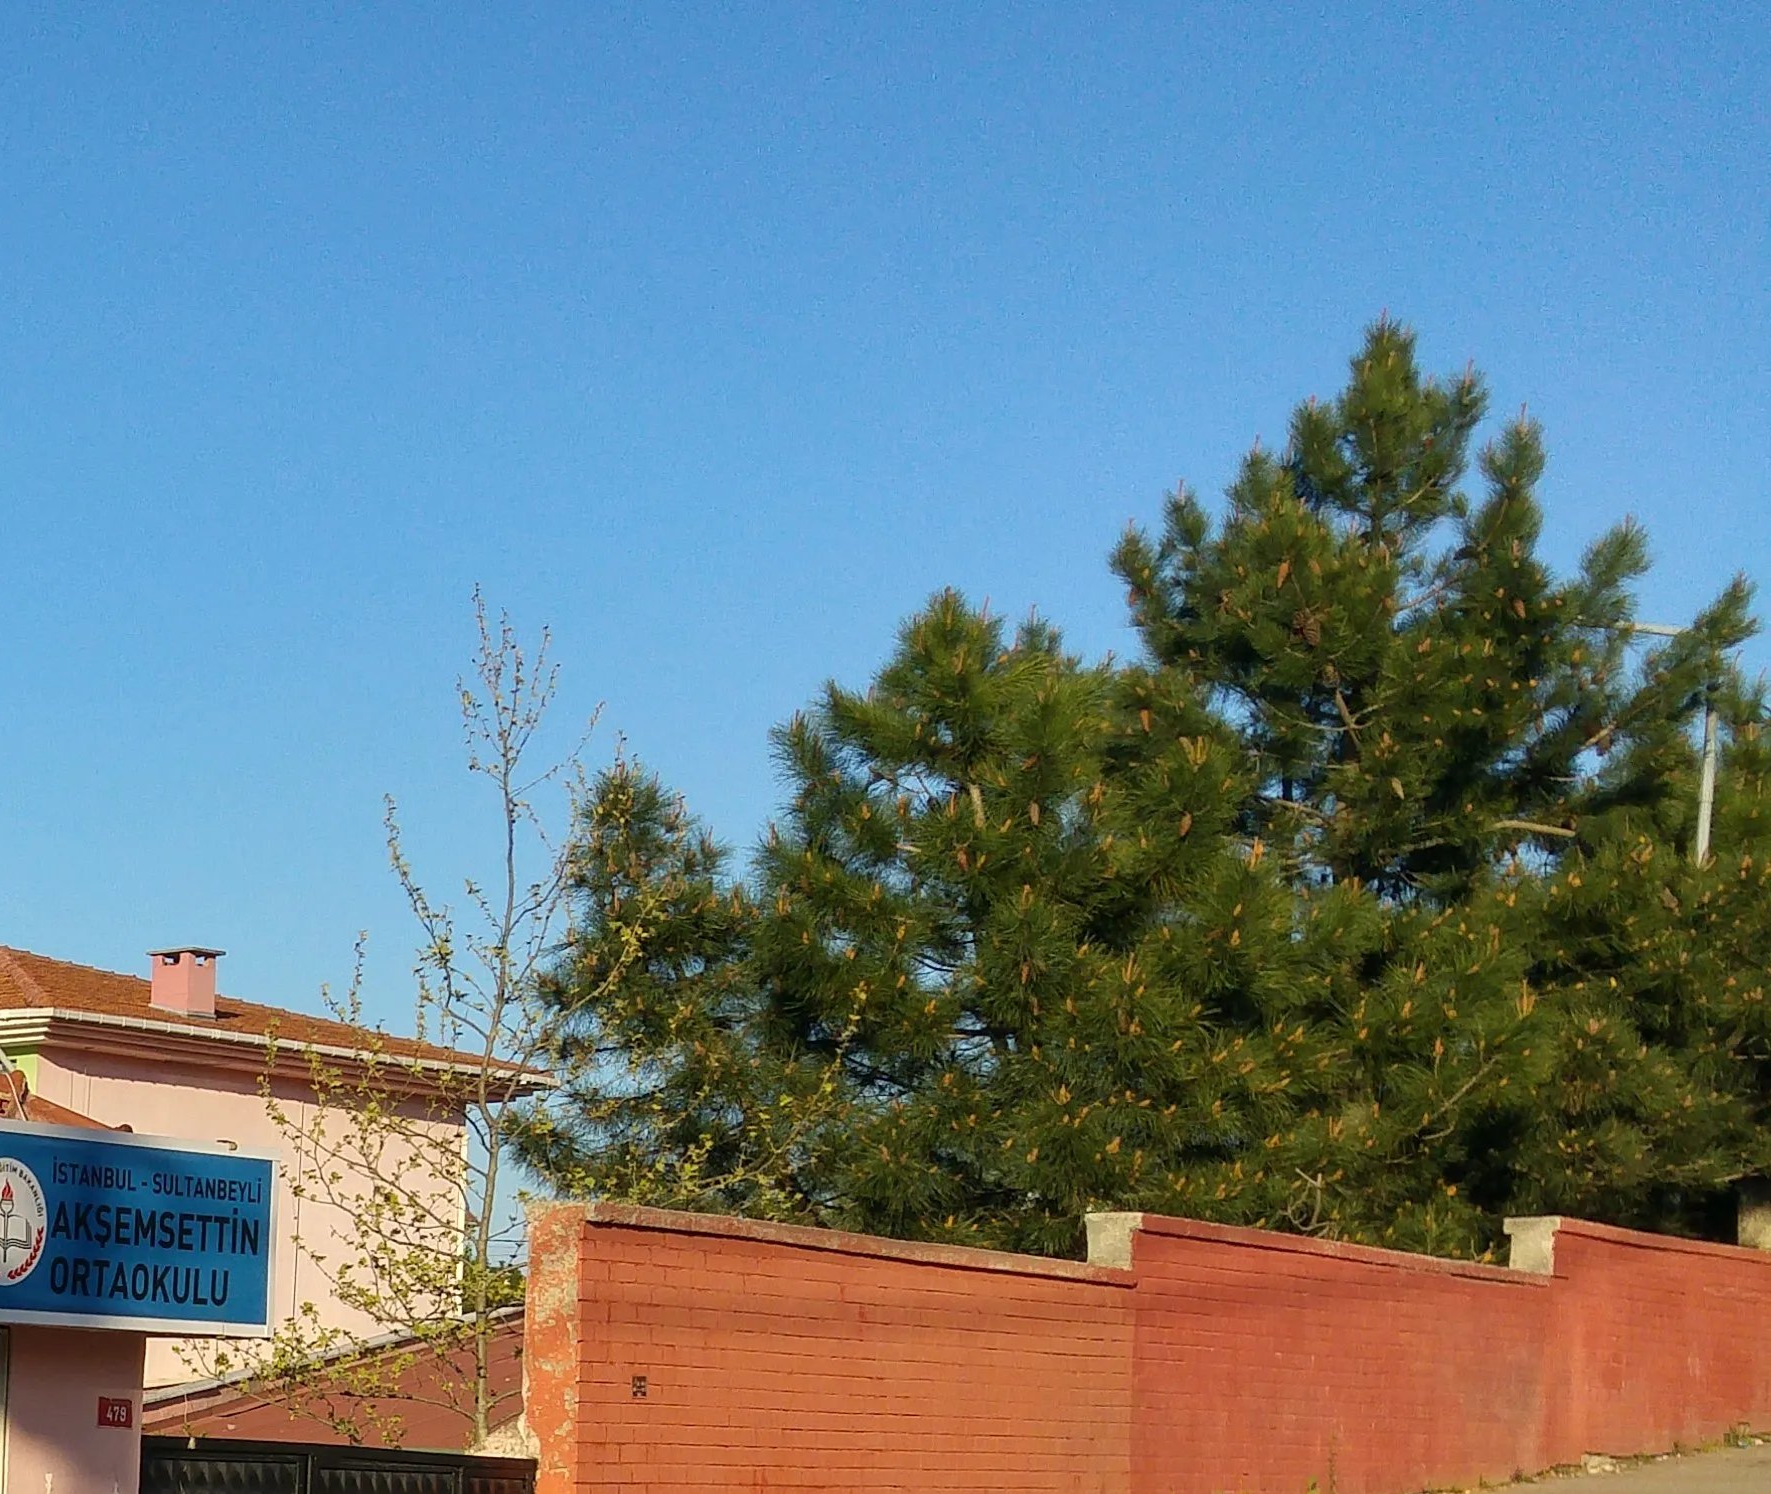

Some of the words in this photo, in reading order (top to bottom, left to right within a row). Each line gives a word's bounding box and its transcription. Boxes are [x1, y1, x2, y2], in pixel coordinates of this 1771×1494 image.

[52, 1156, 137, 1192] İSTANBUL
[152, 1173, 262, 1204] SULTANBEYLİ
[51, 1201, 259, 1256] AKŞEMSETTİN
[50, 1256, 230, 1307] ORTAOKULU
[106, 1405, 127, 1422] 479
